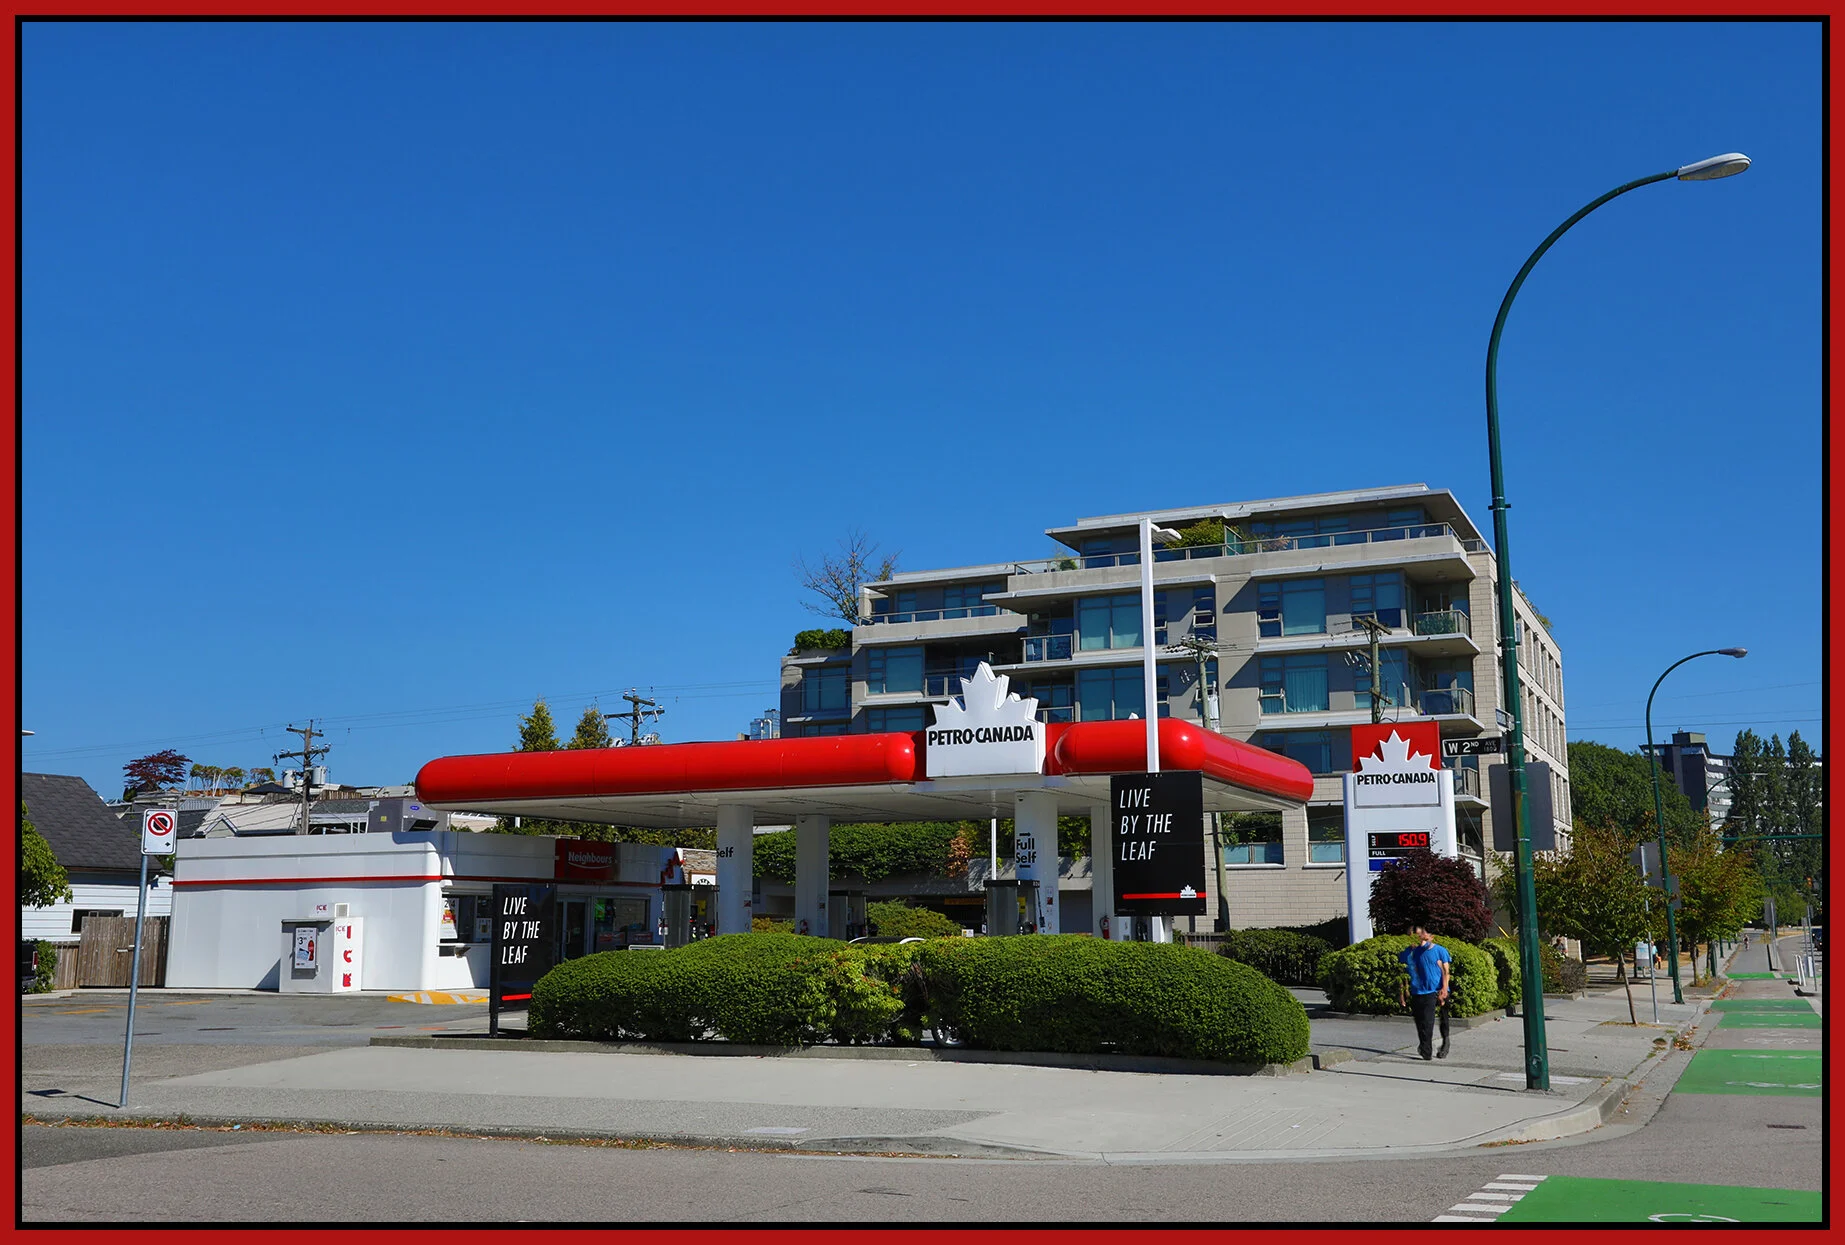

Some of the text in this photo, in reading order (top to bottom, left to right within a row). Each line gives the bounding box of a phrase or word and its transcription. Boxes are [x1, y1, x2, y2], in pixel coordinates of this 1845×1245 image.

[1448, 743, 1459, 753] W
[1462, 741, 1479, 753] 2ND
[1120, 788, 1151, 808] LIVE
[1120, 813, 1173, 834] BY THE
[1016, 838, 1035, 850] Full
[1397, 833, 1427, 846] 150.9
[568, 851, 613, 864] Neighbours
[1016, 851, 1037, 864] Self
[1121, 841, 1157, 860] LEAF
[503, 897, 527, 915] LIVE
[503, 921, 540, 939] BY THE
[502, 945, 528, 964] LEAF
